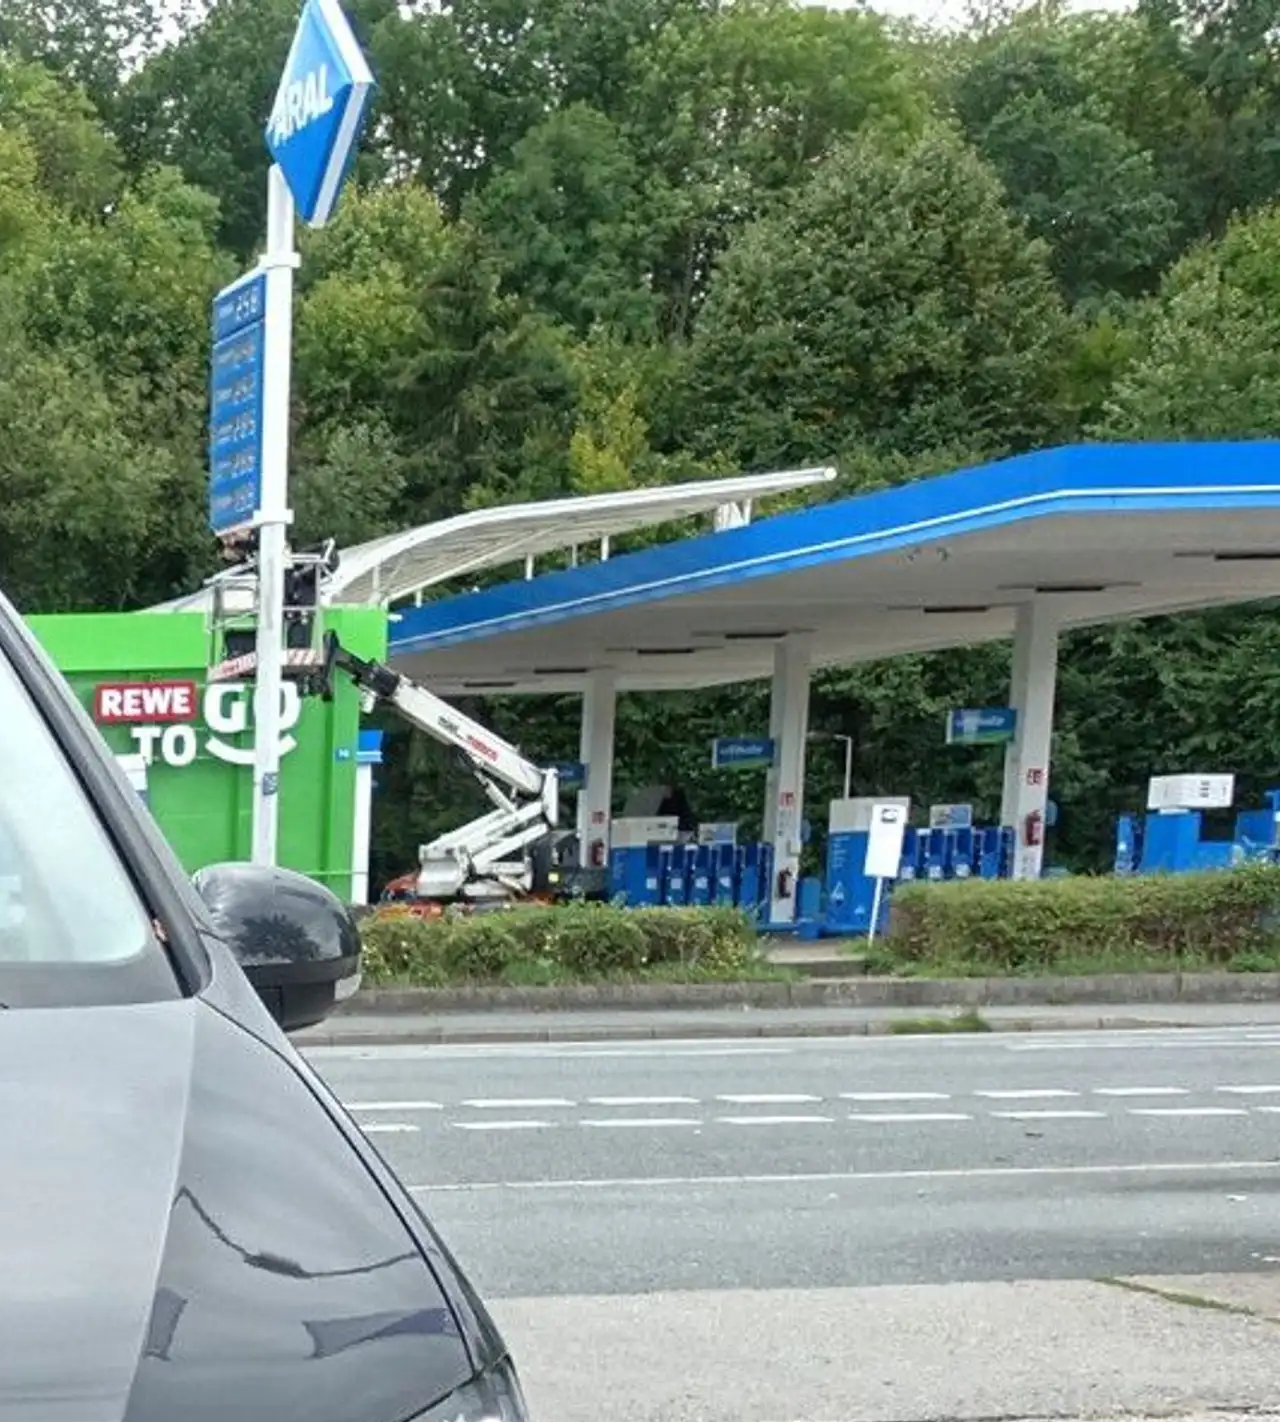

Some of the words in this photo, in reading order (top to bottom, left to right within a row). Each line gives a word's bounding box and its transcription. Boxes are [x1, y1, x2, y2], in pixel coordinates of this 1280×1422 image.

[268, 63, 333, 147] ARAL
[100, 686, 192, 716] REWE
[130, 724, 197, 767] TO
